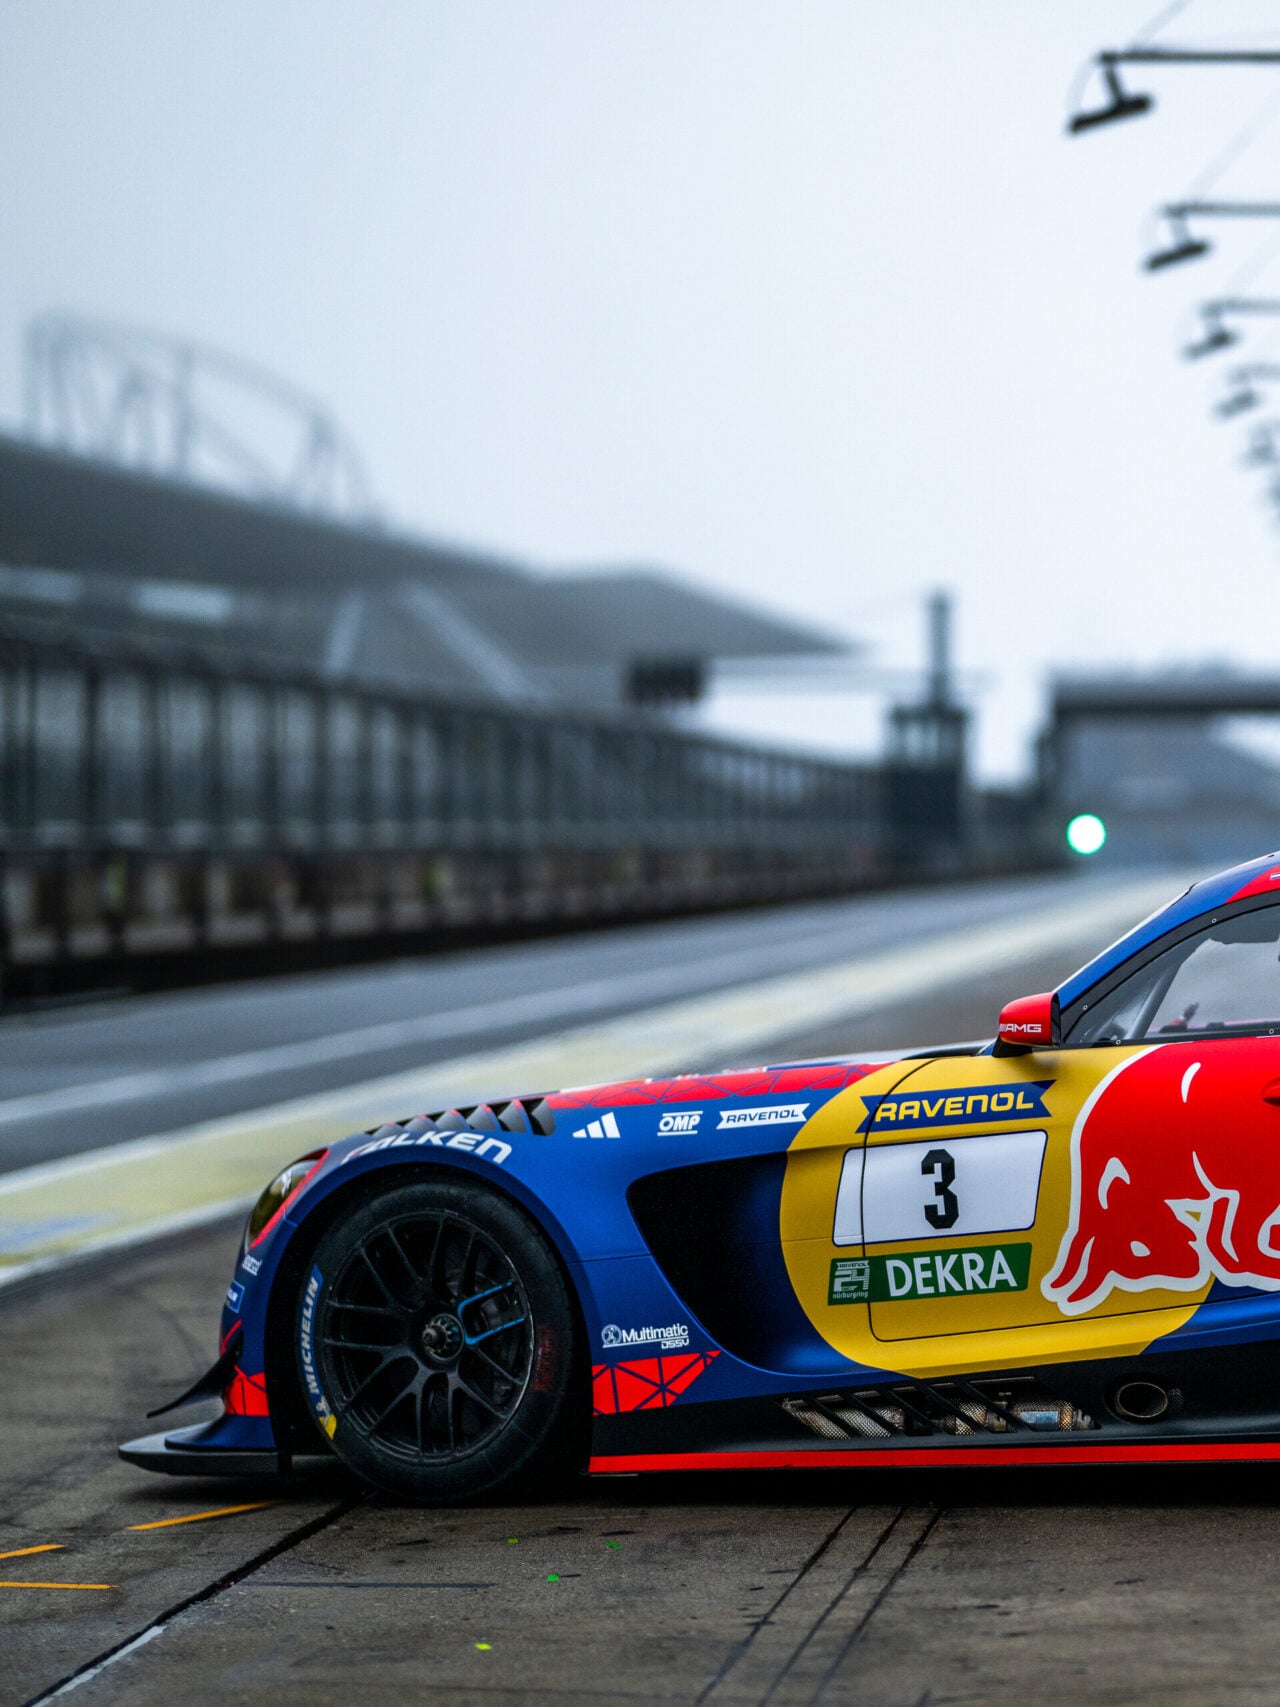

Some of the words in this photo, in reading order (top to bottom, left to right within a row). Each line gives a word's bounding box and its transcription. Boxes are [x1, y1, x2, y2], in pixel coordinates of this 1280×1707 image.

[1005, 1023, 1042, 1033] AMG
[725, 1109, 799, 1124] RAVENOL
[874, 1091, 1034, 1122] RAVENOL
[658, 1115, 701, 1131] OMP
[340, 1130, 513, 1165] FALKEN
[920, 1148, 960, 1230] 3
[885, 1249, 1018, 1297] DEKRA
[301, 1275, 320, 1394] MICHELIN
[622, 1323, 689, 1343] Multimatic
[661, 1338, 690, 1350] DSSV
